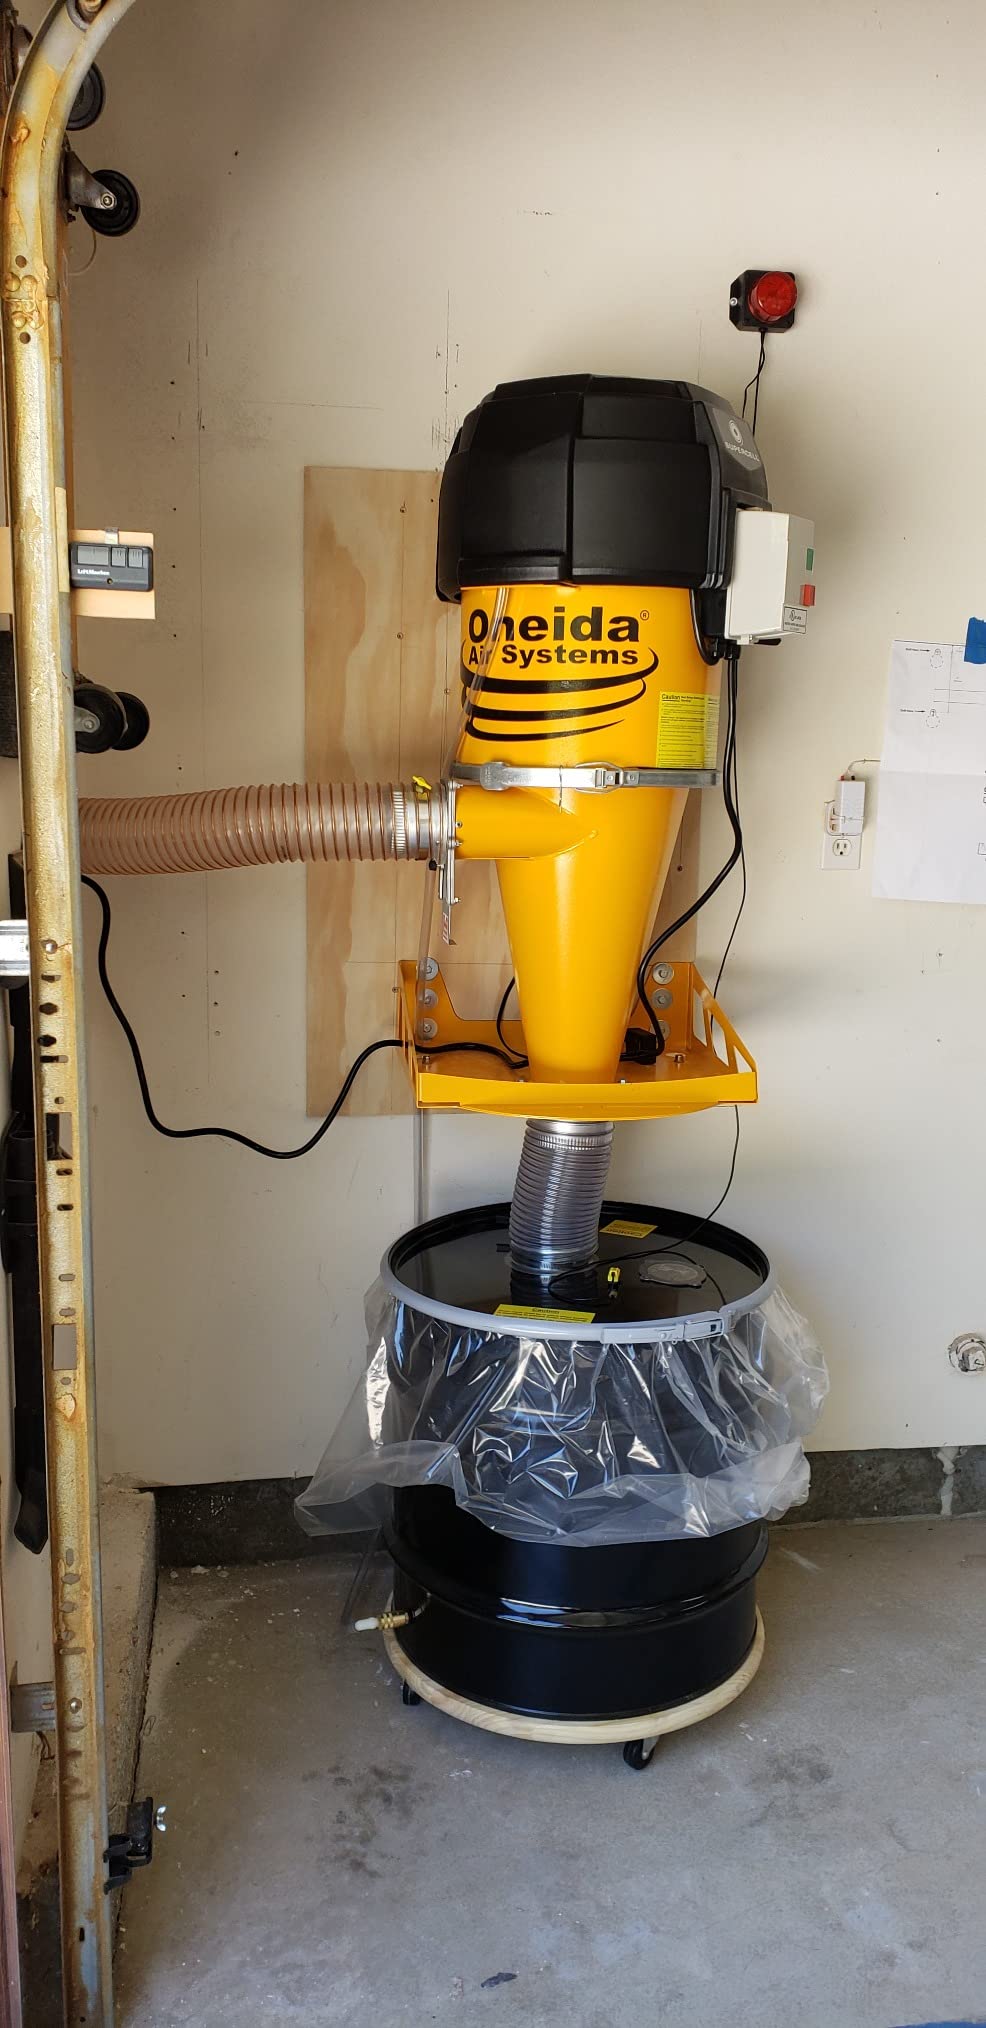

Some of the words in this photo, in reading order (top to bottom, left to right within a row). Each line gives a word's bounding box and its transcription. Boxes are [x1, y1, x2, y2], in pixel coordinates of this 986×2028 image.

[468, 606, 640, 643] Oneida
[501, 643, 639, 669] Systems
[661, 692, 681, 701] Caution
